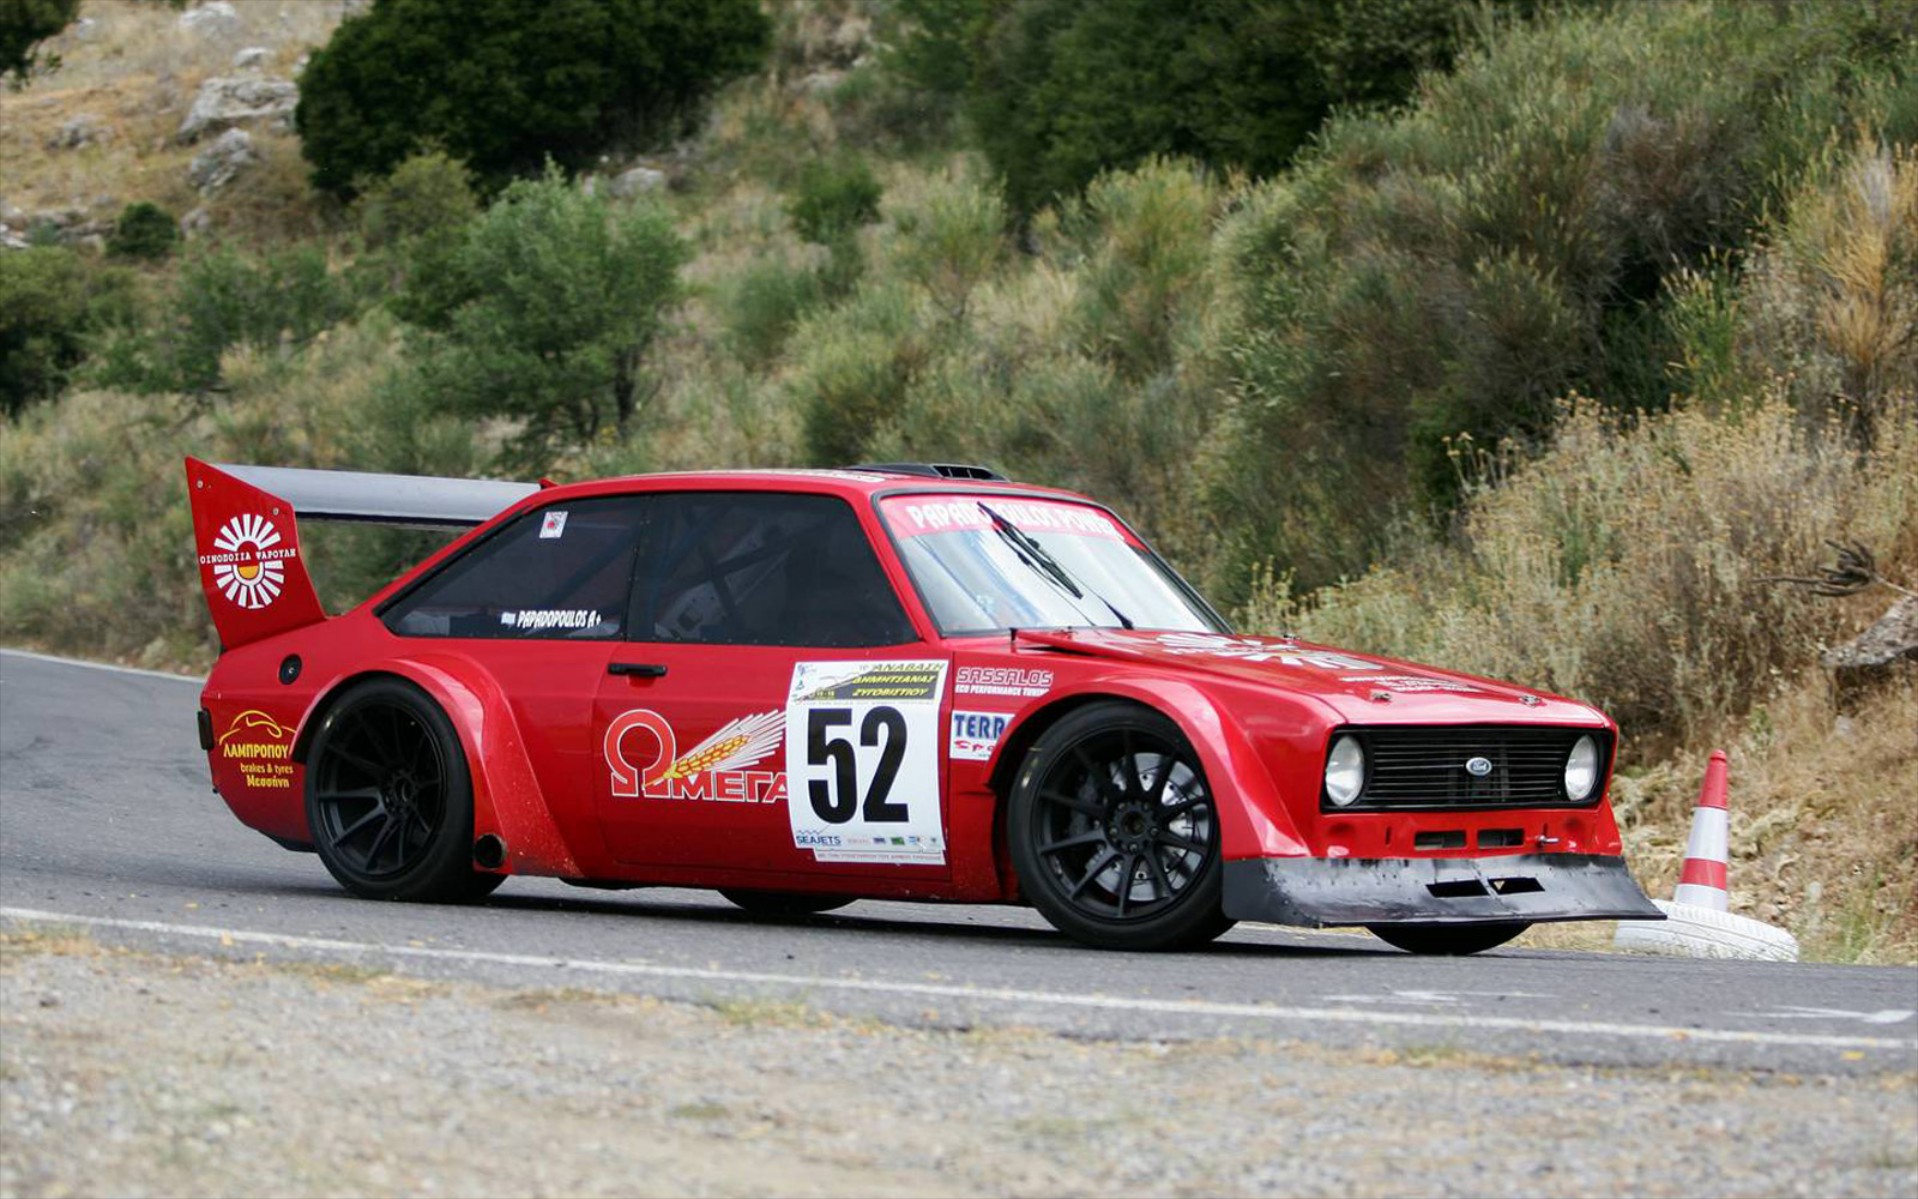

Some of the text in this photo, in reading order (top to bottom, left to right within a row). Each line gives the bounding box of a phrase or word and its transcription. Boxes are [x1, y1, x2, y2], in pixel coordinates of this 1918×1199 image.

[517, 610, 587, 629] PAPADOPOULOS
[956, 667, 1054, 687] SASSALOS
[955, 684, 970, 694] ECO
[970, 685, 1022, 696] PERFORMANCE
[240, 763, 294, 775] brakes & tyres
[808, 706, 909, 824] 52
[797, 836, 841, 846] SEAJETS
